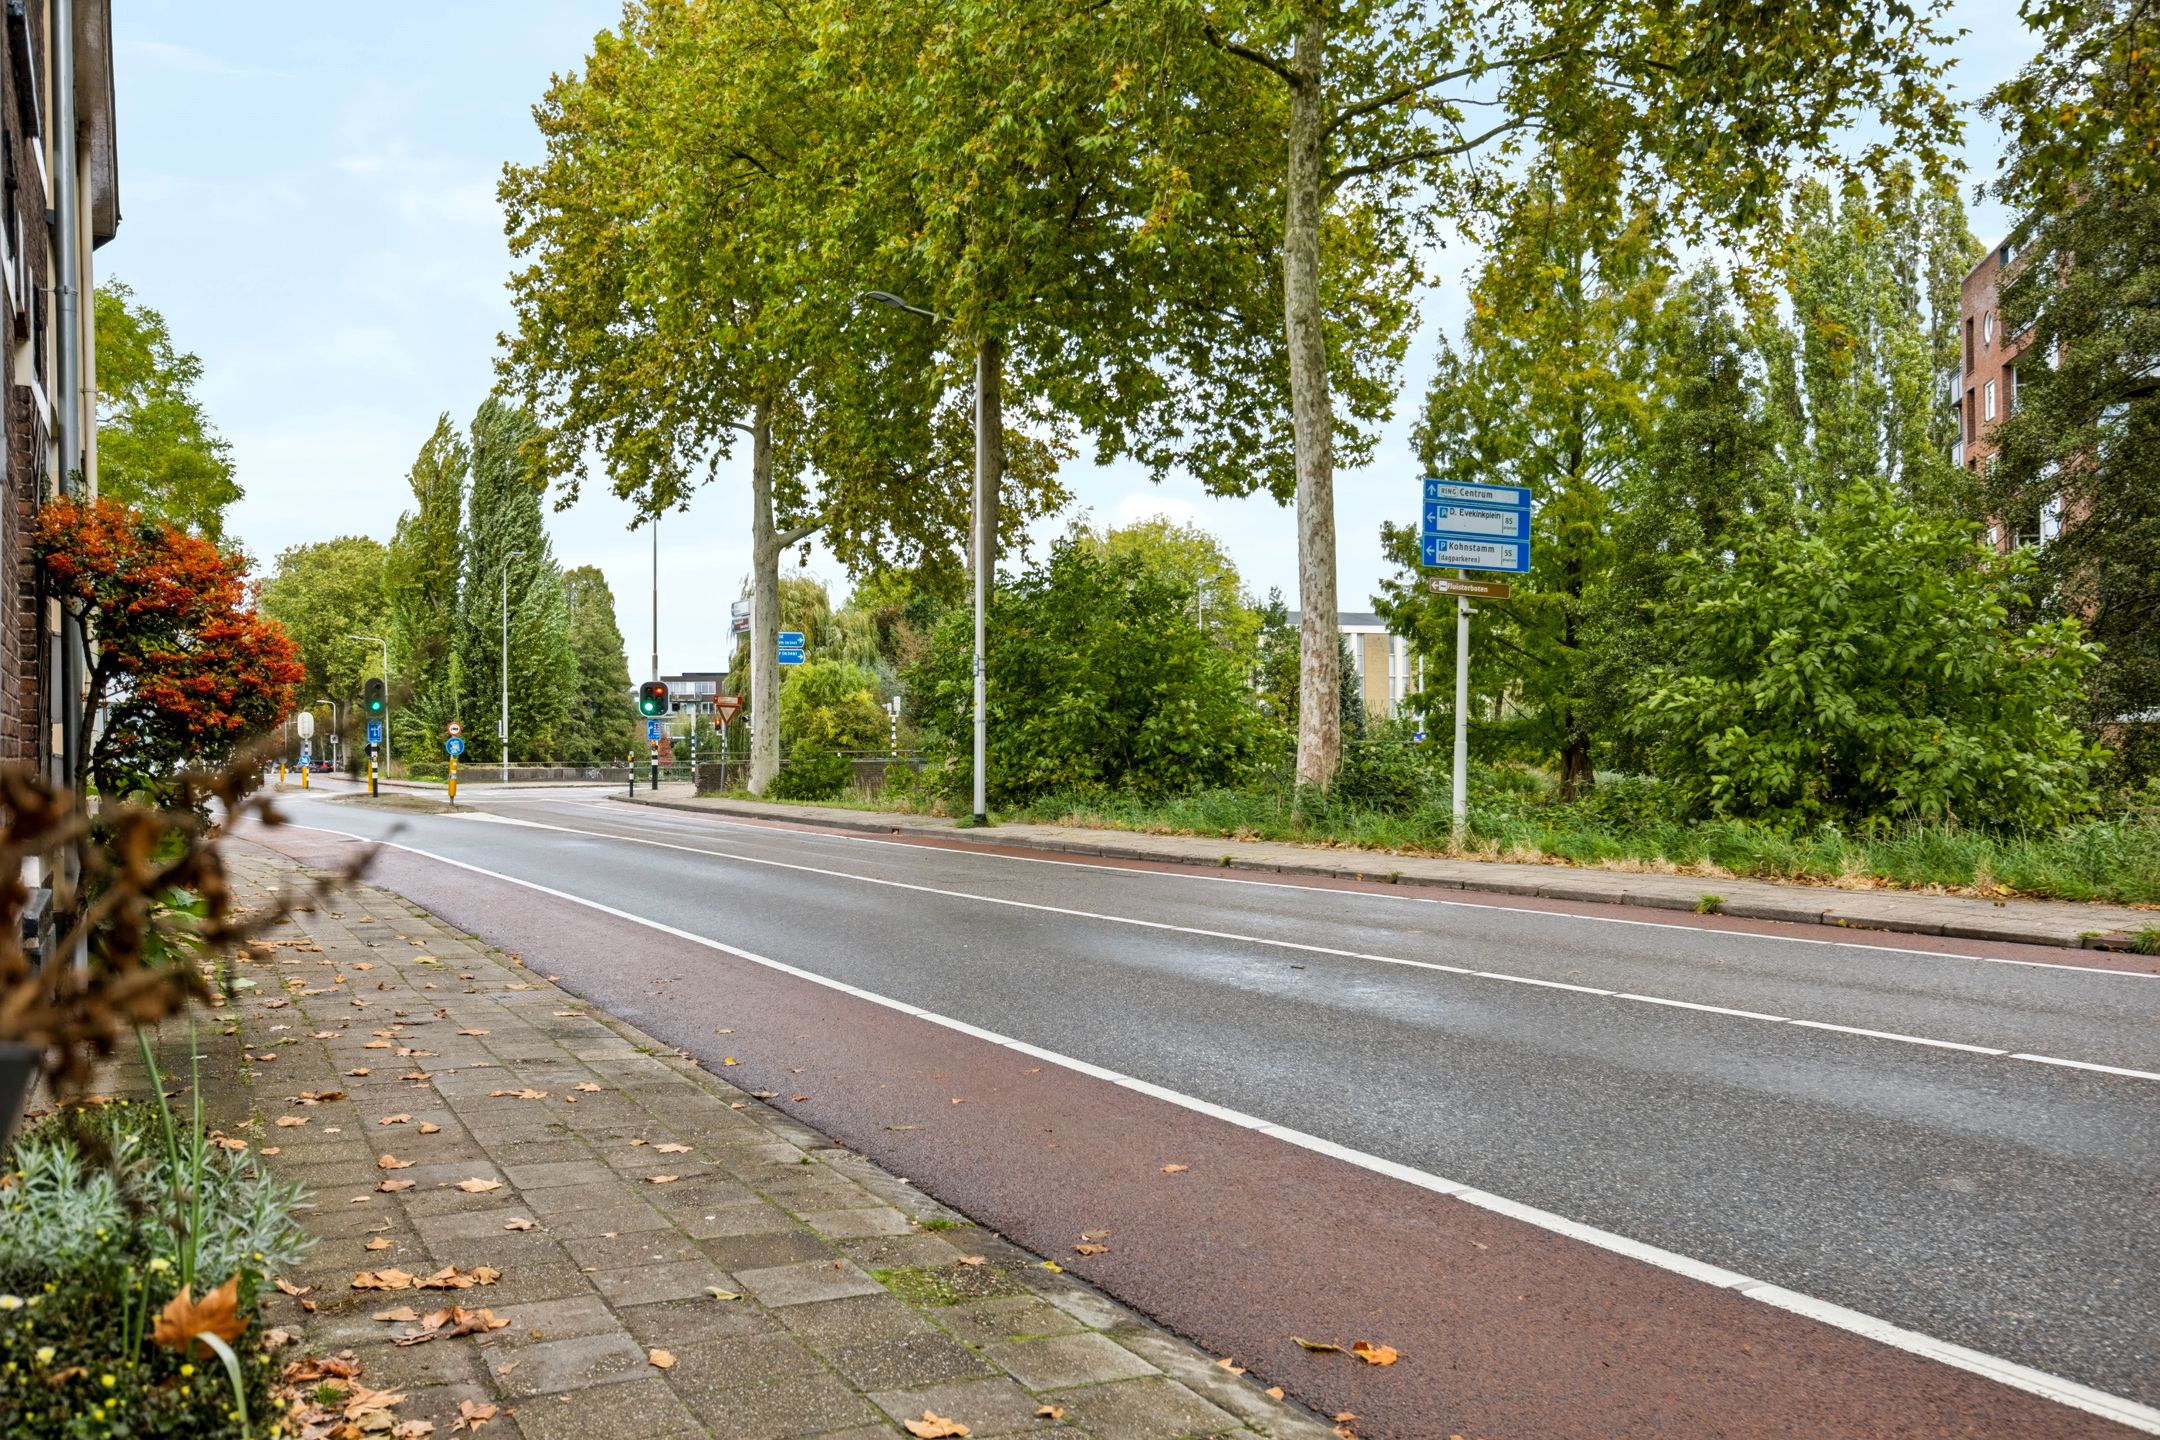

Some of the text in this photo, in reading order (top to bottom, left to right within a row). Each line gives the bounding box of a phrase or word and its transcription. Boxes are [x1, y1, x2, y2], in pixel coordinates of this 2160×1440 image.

[1441, 487, 1493, 499] RING Centrum
[1449, 508, 1457, 516] D.
[1459, 509, 1500, 520] Evekinkplein
[1505, 517, 1513, 525] 85
[1449, 542, 1495, 553] Kohnstamm
[1504, 549, 1513, 557] 55
[1438, 554, 1480, 563] (dagparkeren)
